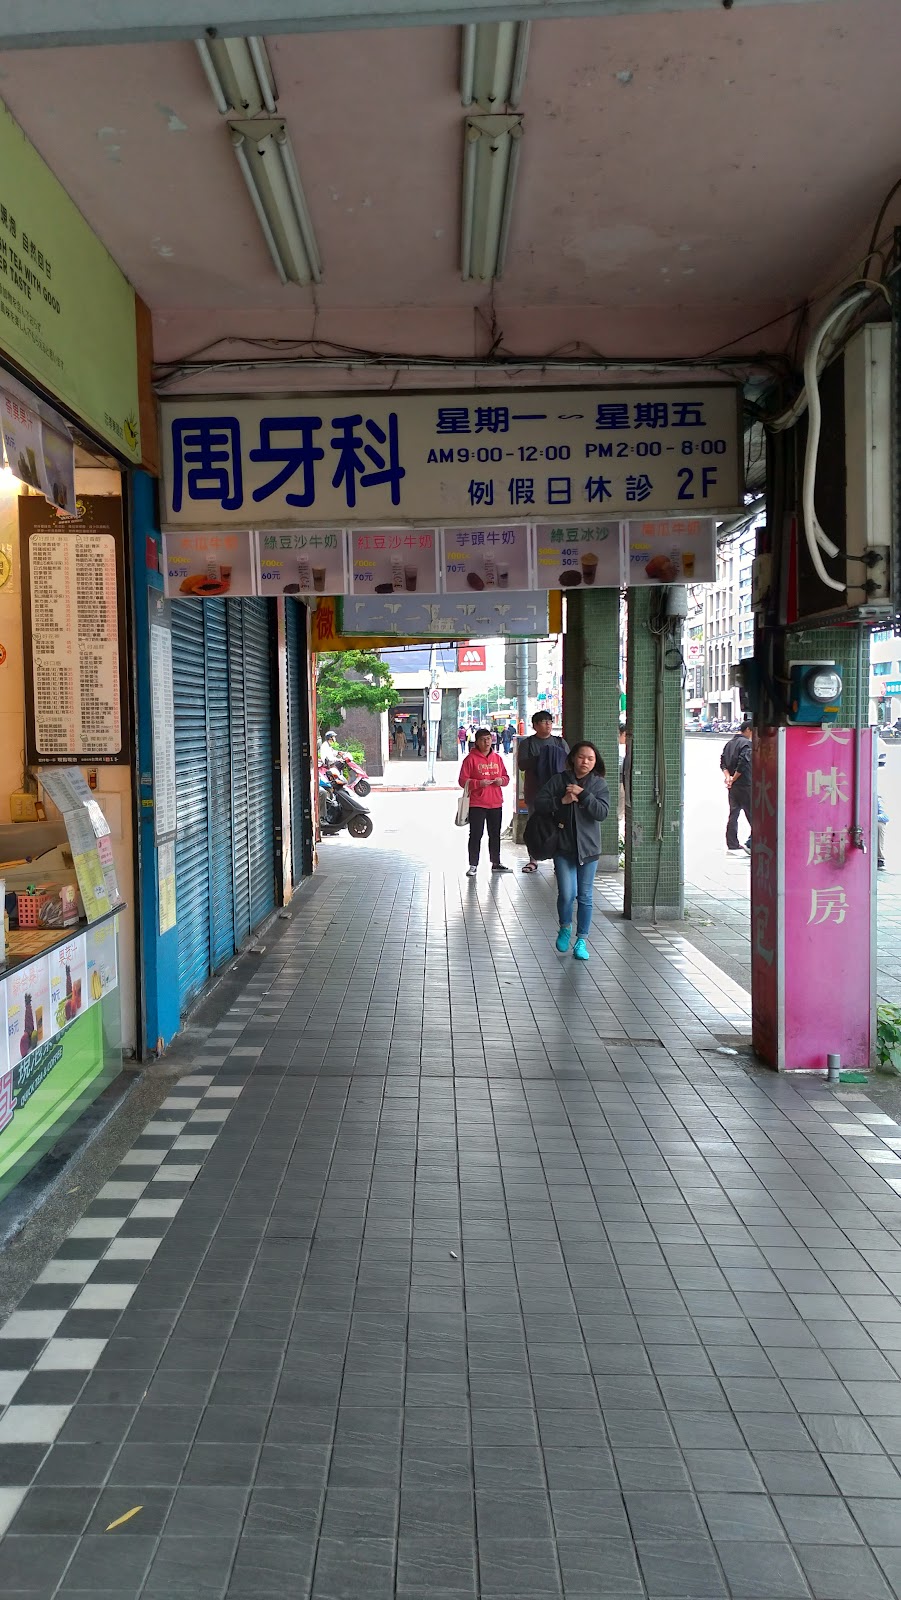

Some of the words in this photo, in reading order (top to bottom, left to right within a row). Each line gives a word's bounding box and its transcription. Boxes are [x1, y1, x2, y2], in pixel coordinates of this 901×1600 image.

[9, 247, 23, 272] TEA
[24, 264, 42, 295] WITH
[43, 286, 61, 315] GOOD
[9, 265, 32, 301] TASTE
[171, 412, 405, 512] 周牙科
[467, 474, 654, 506] 例假日休診
[676, 466, 718, 500] 2F
[263, 534, 338, 550] 綠豆沙牛奶
[357, 534, 433, 550] 紅豆沙牛奶
[456, 530, 515, 547] 芋頭牛奶
[550, 526, 609, 543] 綠豆冰沙
[561, 548, 579, 556] 40元
[630, 552, 650, 563] 70元
[261, 559, 284, 568] 700cc
[353, 559, 377, 567] 700cc
[447, 563, 466, 573] 70元
[562, 558, 579, 566] 50元
[168, 568, 189, 578] 65元
[261, 570, 281, 580] 60元
[354, 572, 374, 582] 70元
[316, 606, 334, 640] 微
[58, 940, 78, 967] 果菜汁
